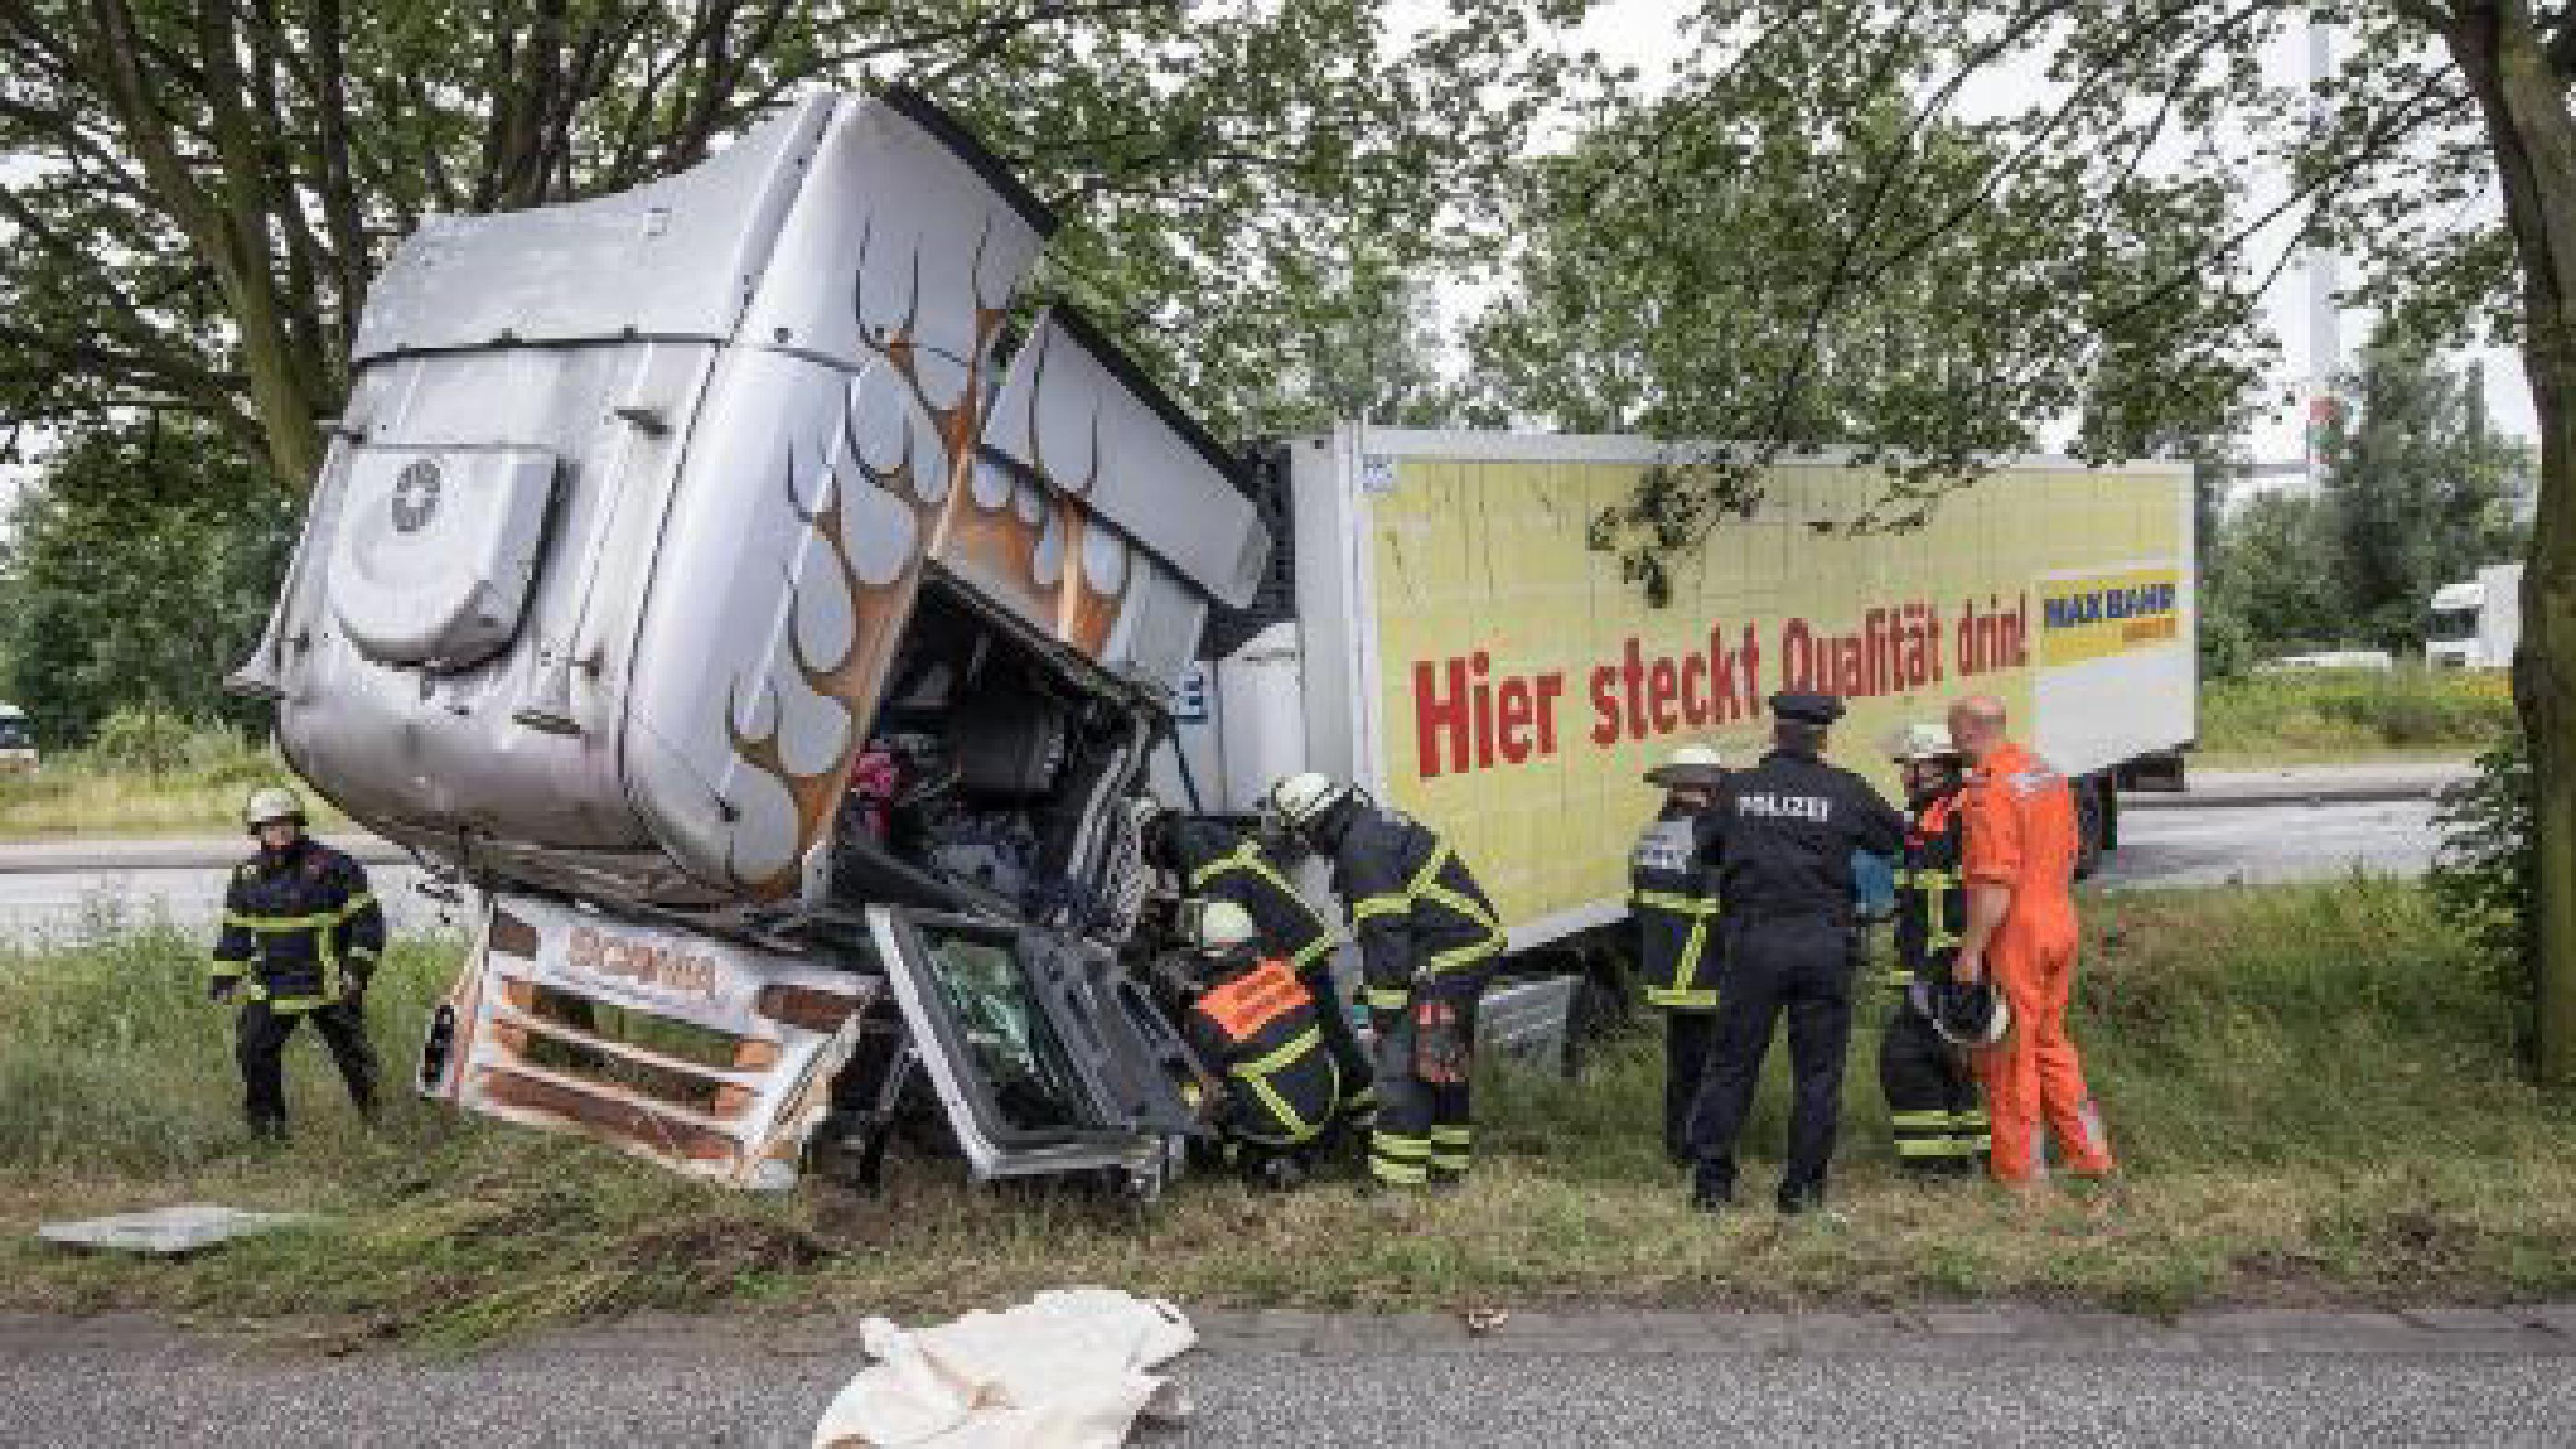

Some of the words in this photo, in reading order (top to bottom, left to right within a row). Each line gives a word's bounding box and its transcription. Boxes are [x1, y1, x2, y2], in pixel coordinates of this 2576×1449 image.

[2045, 590, 2102, 627] MAX
[2106, 582, 2176, 619] BAHR
[1411, 651, 1562, 778] Hier
[1589, 619, 1763, 747] steckt
[1783, 603, 1945, 696] Qualität
[1957, 592, 2027, 678] drin!
[1737, 793, 1831, 823] POLIZEI
[569, 926, 717, 1000] SCANIA
